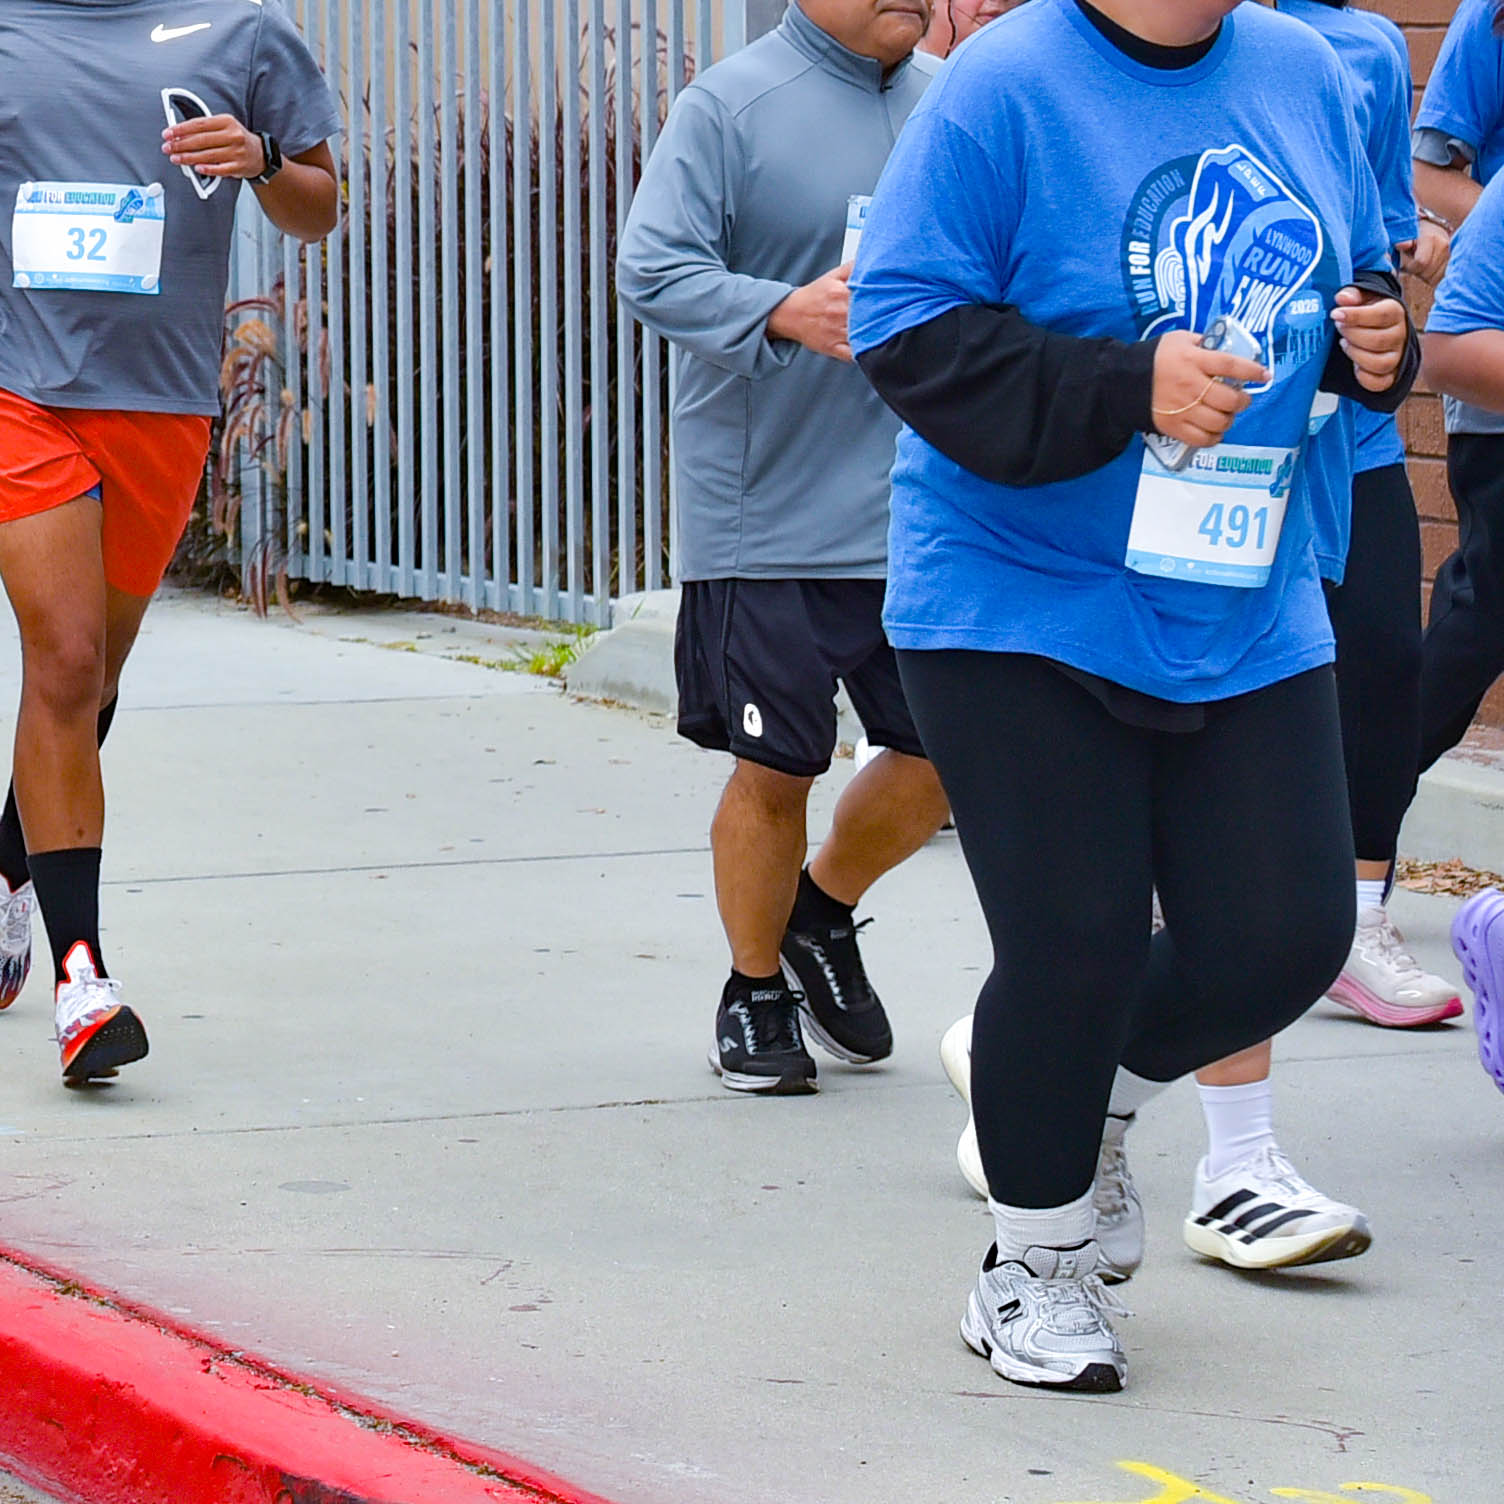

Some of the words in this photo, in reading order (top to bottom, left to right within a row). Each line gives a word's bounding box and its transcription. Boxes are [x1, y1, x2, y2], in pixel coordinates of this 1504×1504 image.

[1235, 162, 1268, 196] LPEF
[1131, 168, 1186, 240] EDUCATION
[65, 227, 108, 262] 32
[1128, 240, 1151, 275] FOR
[1264, 227, 1313, 267] LYNWOOD
[1242, 245, 1300, 286] RUN
[1188, 452, 1215, 472] FOR
[1215, 454, 1274, 476] EDUCATION
[1197, 502, 1269, 550] 491
